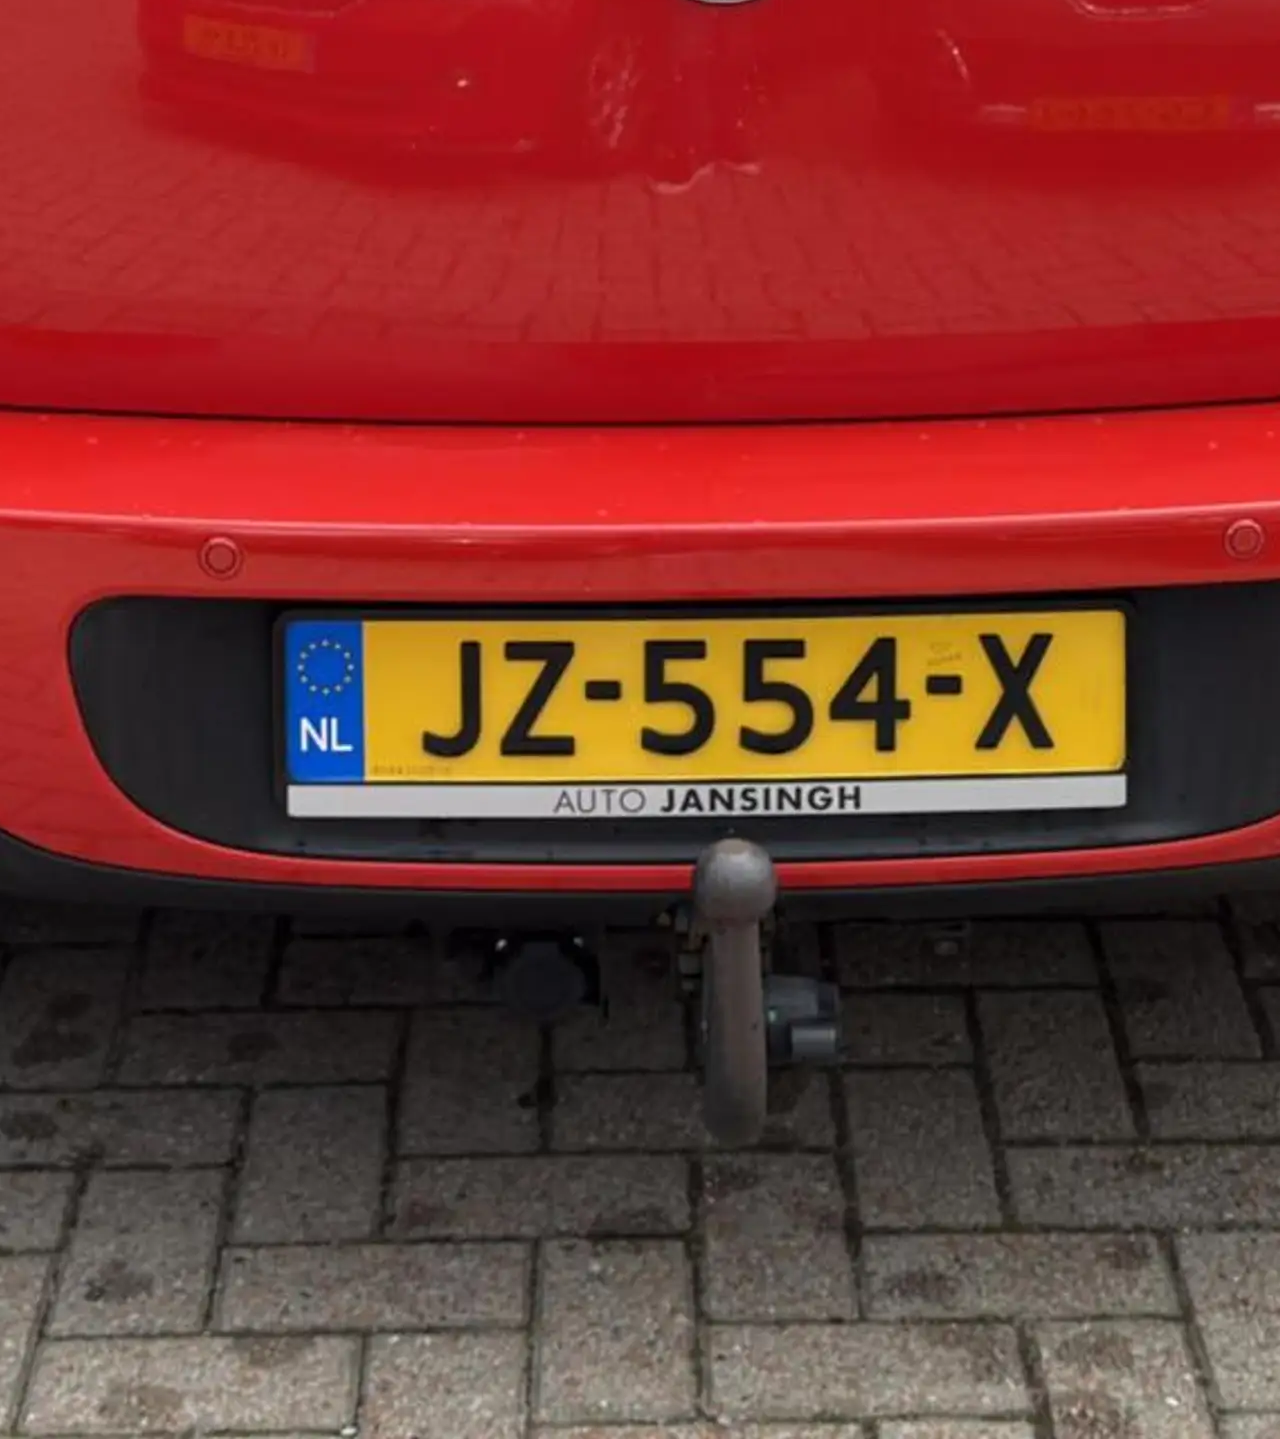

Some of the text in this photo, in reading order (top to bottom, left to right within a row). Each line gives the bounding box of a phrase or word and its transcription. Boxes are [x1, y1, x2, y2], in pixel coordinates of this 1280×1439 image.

[421, 632, 1055, 758] JZ-554-X
[298, 716, 354, 754] NL
[553, 785, 864, 816] AUTO JANSINGH
